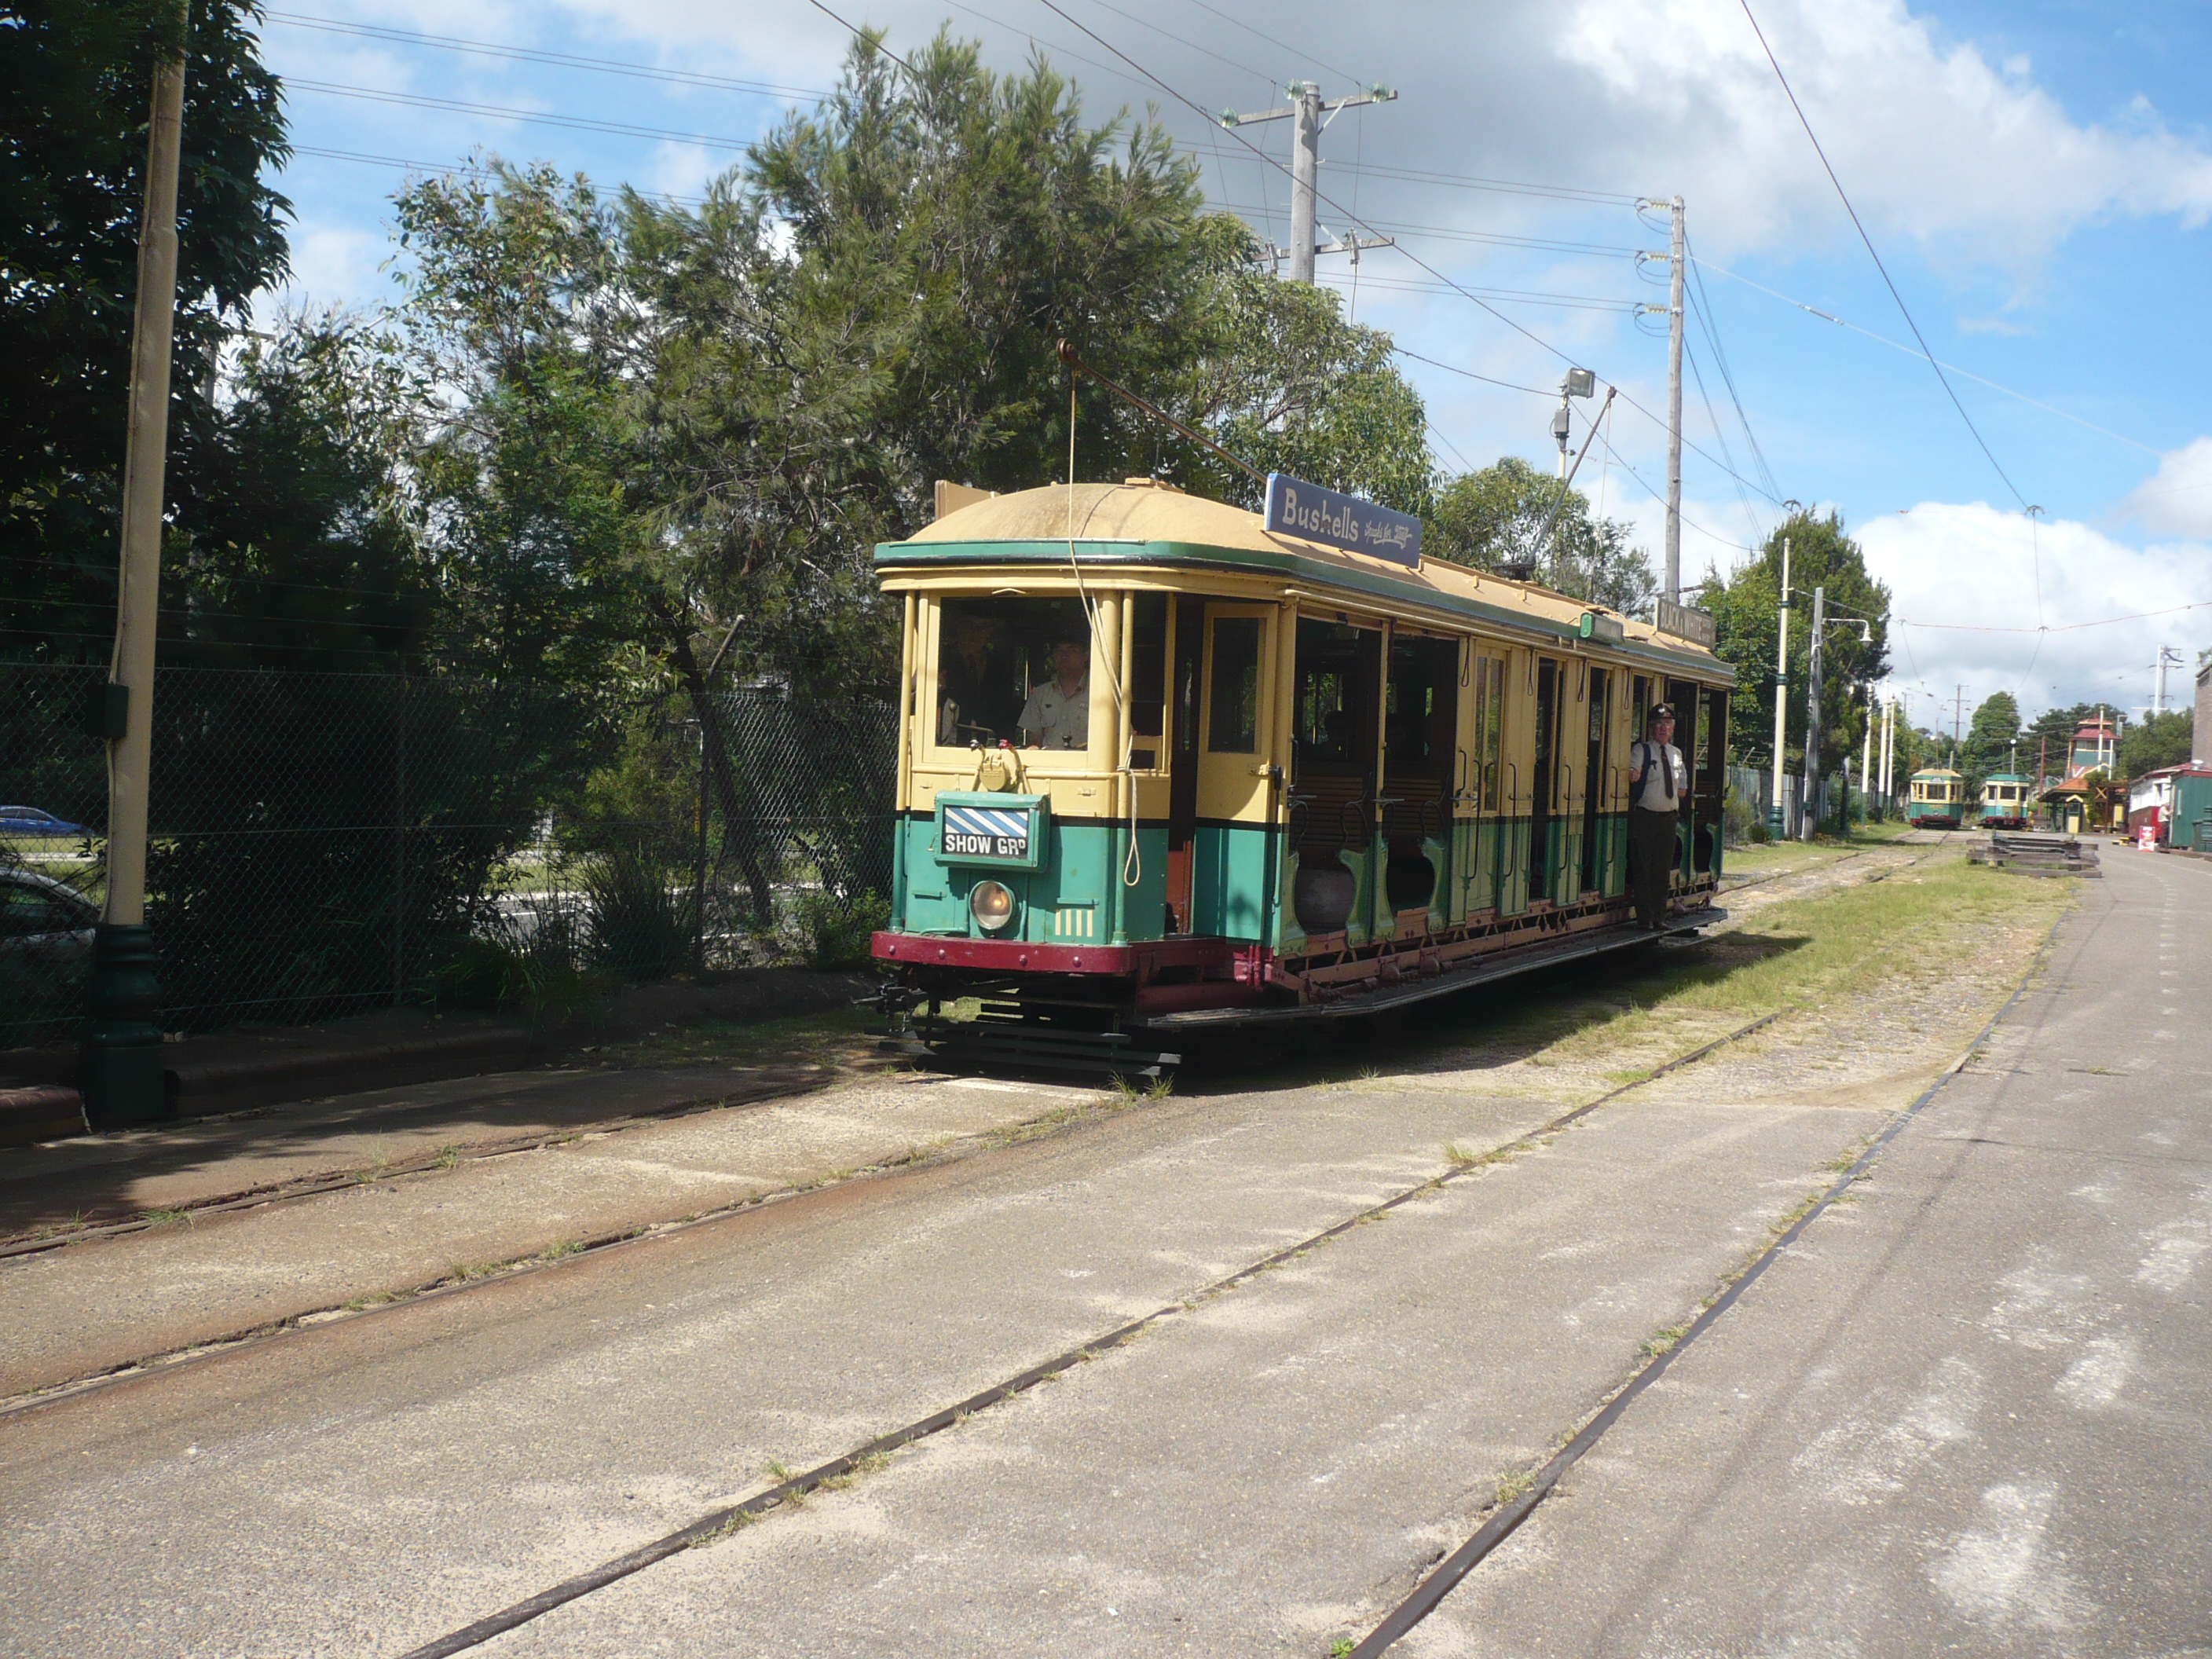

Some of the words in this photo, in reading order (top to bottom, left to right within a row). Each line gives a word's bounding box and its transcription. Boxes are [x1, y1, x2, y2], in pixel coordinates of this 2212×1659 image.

[1282, 487, 1359, 542] Bushells
[1684, 610, 1703, 640] WHITE
[946, 834, 991, 854] SHOW
